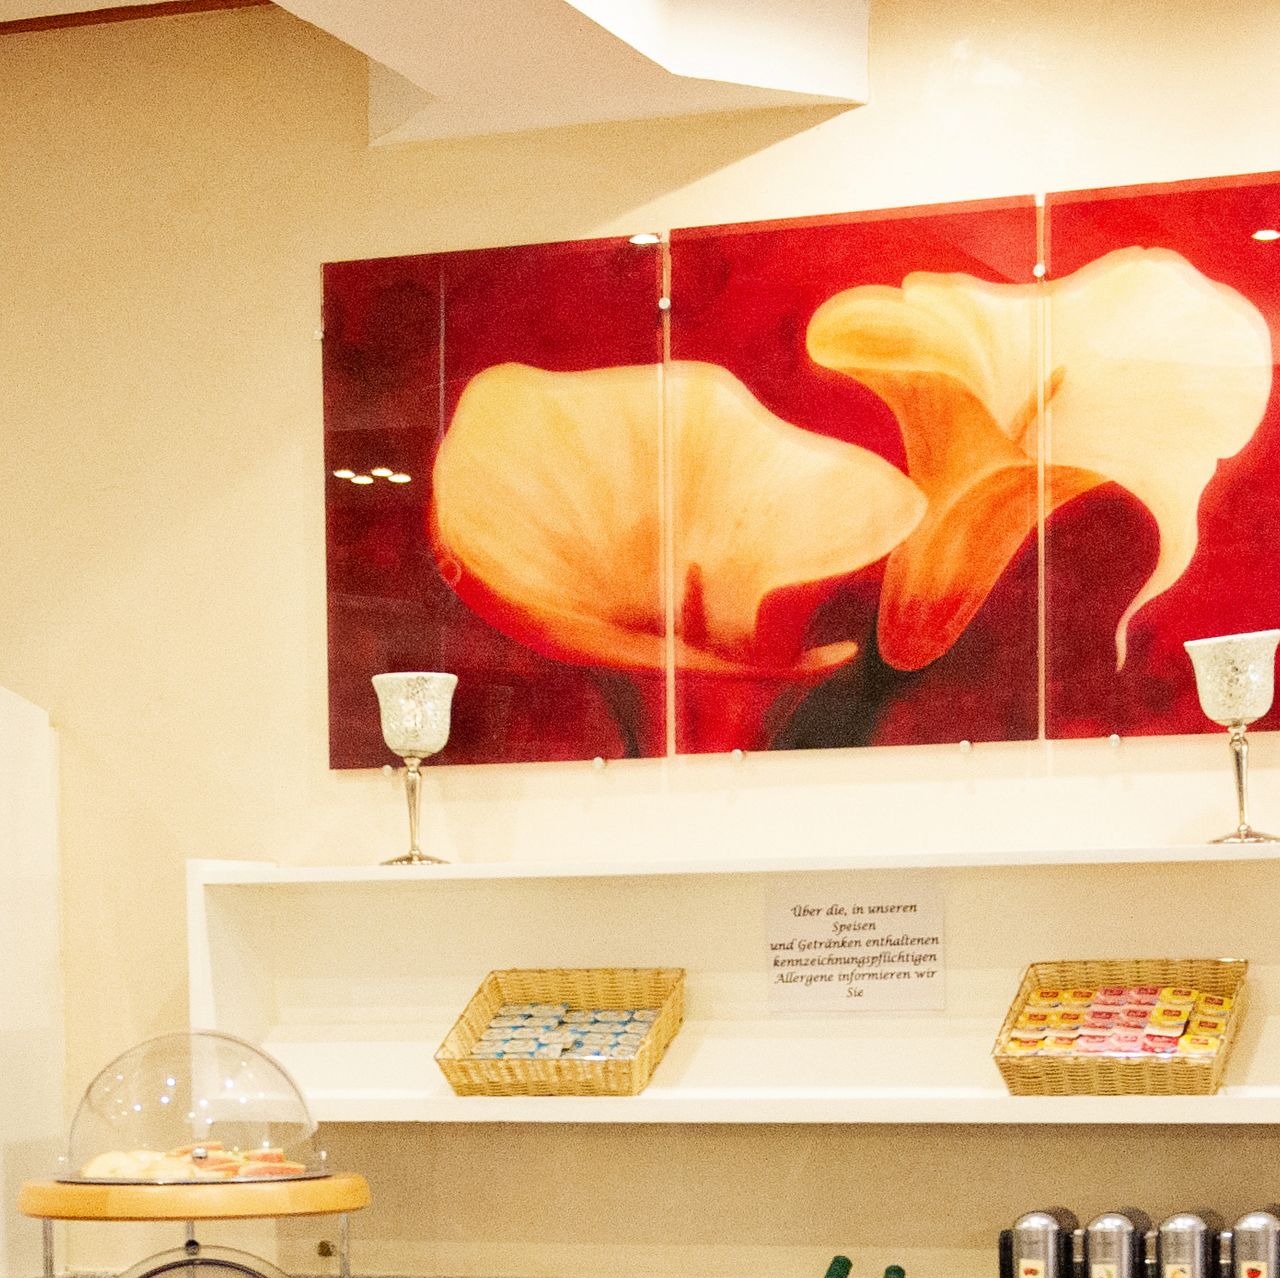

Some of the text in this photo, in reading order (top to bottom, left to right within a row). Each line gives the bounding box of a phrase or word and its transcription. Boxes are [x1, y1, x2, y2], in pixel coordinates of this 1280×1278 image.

[826, 903, 847, 916] die,
[852, 904, 864, 915] in
[868, 904, 917, 914] unseren
[832, 920, 876, 935] Speisen
[770, 934, 939, 952] und Getränken enthaltenen
[773, 951, 937, 968] kennzeichnungspflichtigen
[774, 969, 937, 986] Allergene informieren wir
[847, 987, 864, 998] Sie
